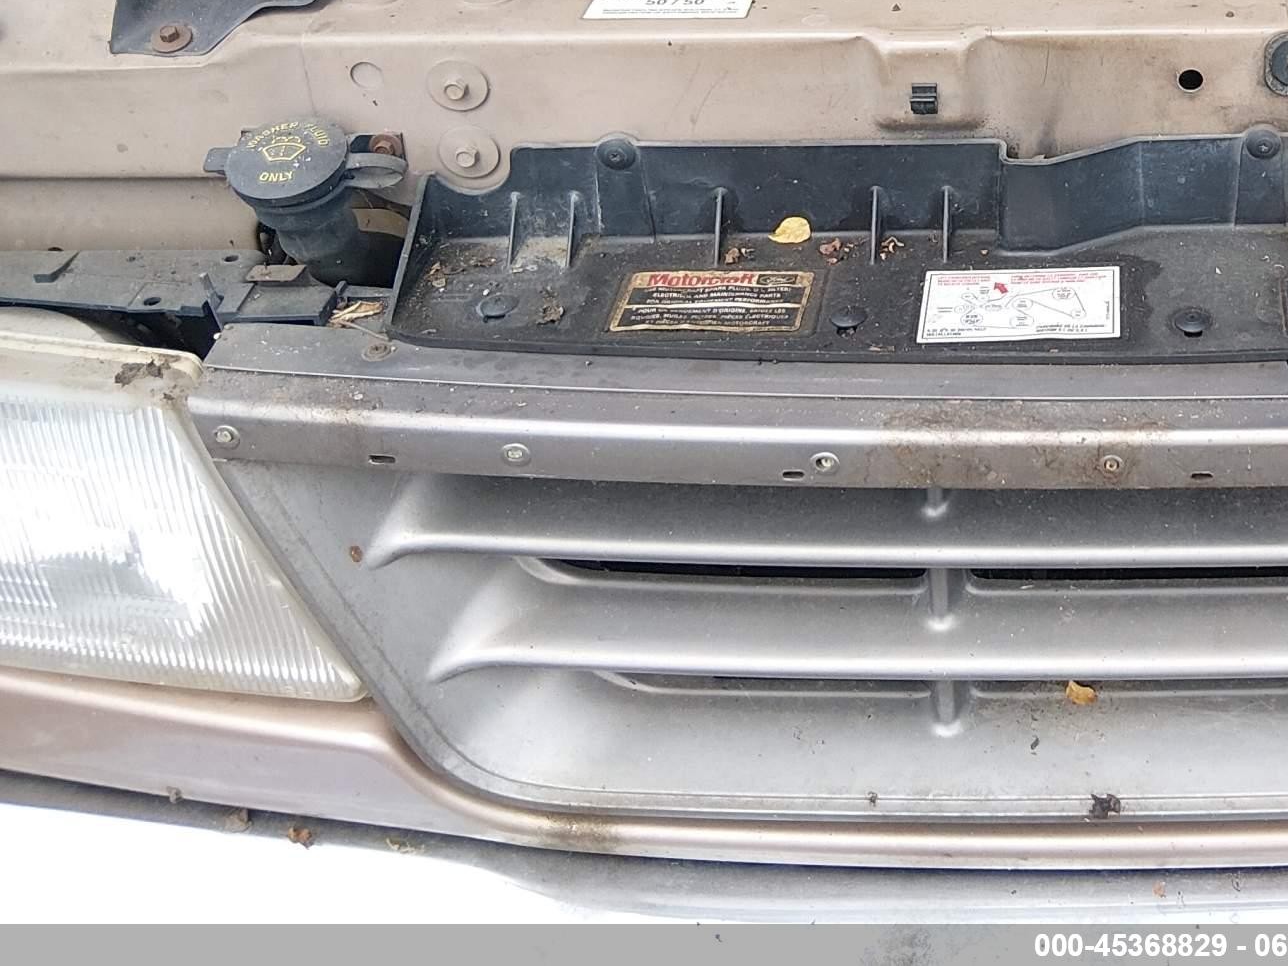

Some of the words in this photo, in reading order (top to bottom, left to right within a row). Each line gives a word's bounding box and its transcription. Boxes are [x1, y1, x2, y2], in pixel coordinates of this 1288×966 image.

[304, 123, 330, 147] FLUID
[259, 171, 293, 182] ONLY
[649, 273, 755, 286] Motorcraft
